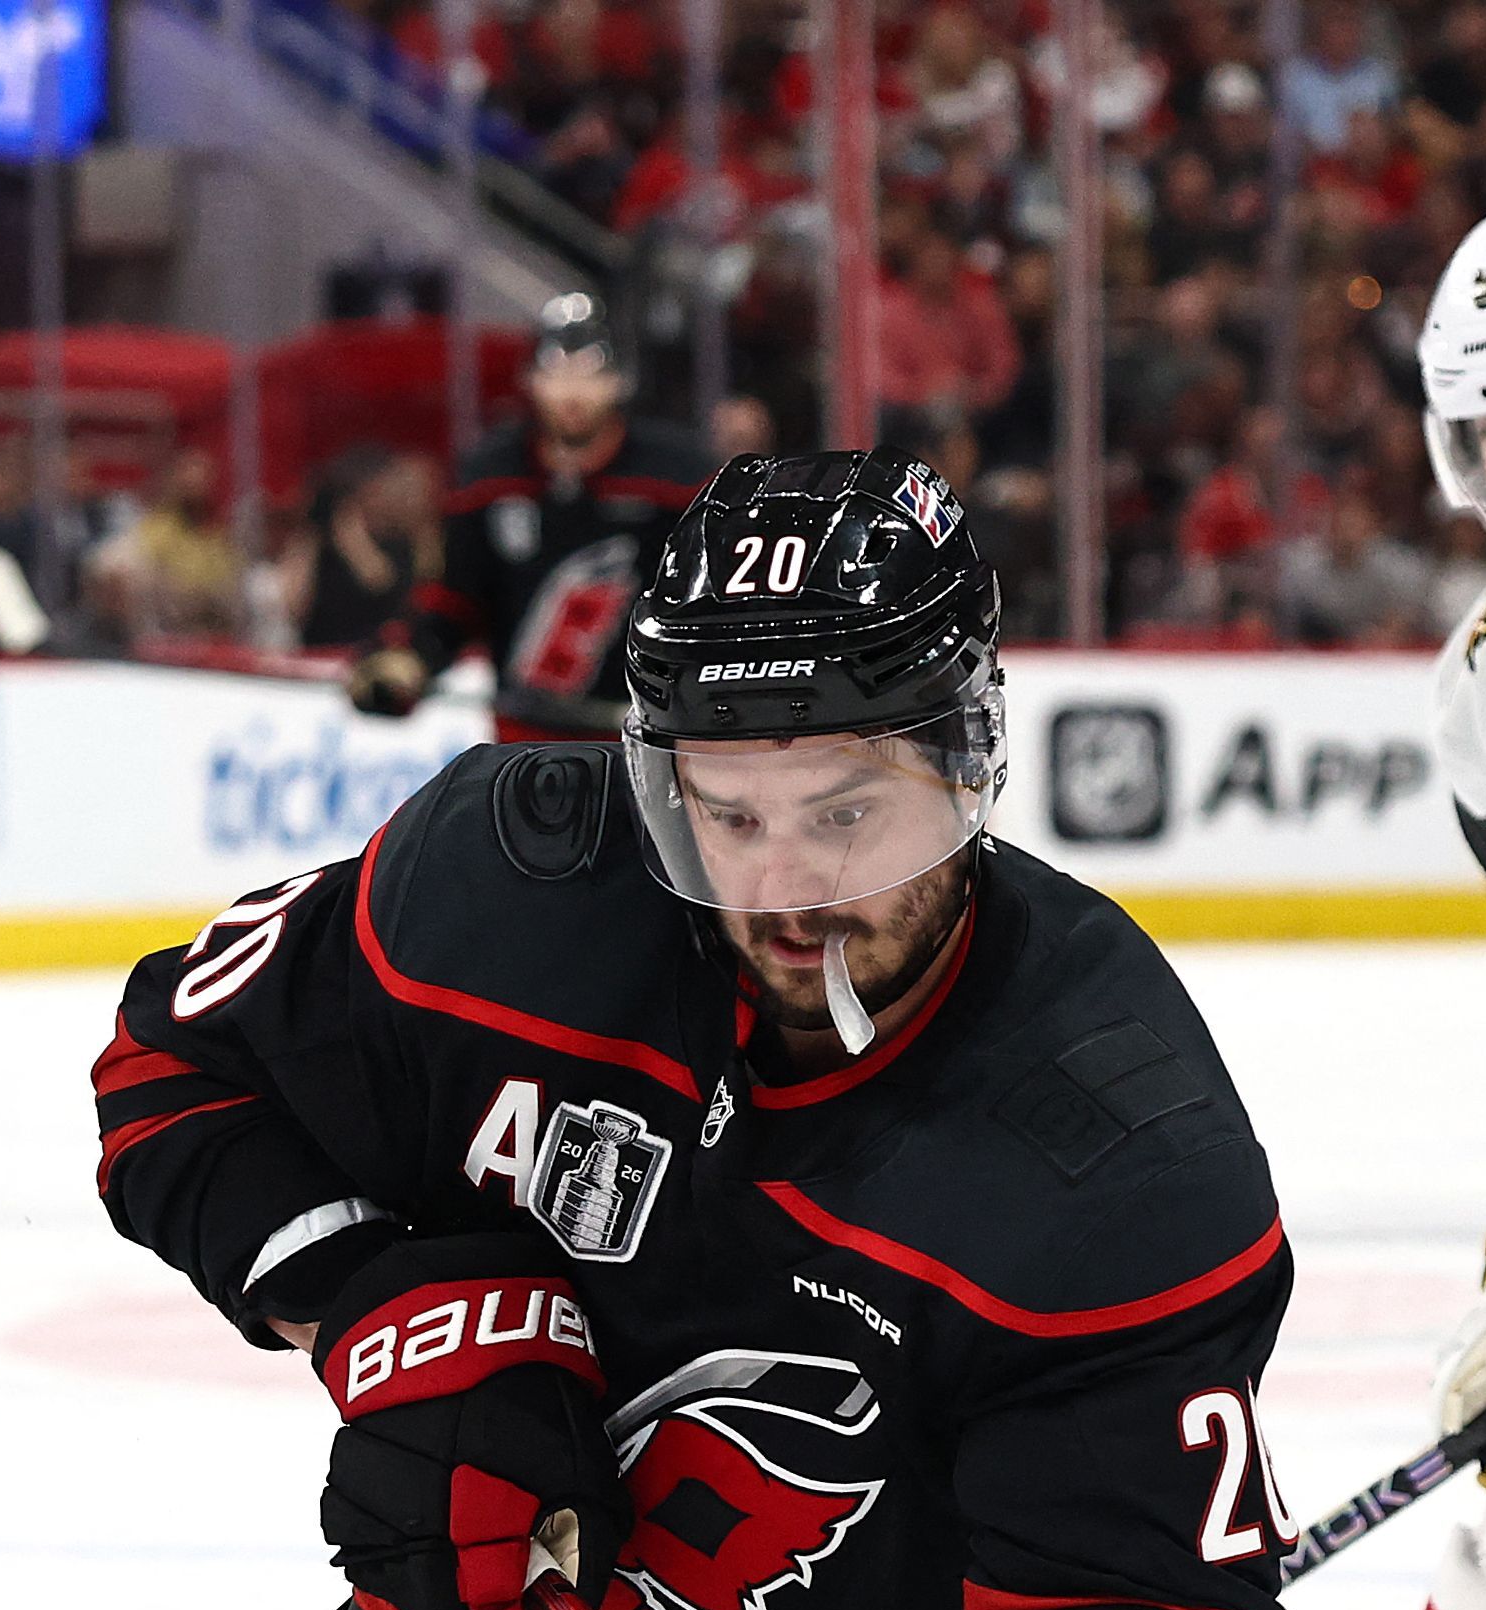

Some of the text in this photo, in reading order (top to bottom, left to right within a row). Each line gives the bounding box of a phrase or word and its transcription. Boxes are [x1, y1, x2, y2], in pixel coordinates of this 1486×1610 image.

[724, 535, 808, 595] 20
[697, 658, 817, 684] BAUER
[1201, 722, 1437, 832] App
[171, 869, 326, 1023] 20
[462, 1076, 545, 1209] A
[560, 1139, 583, 1159] 20
[620, 1163, 644, 1184] 26
[346, 1289, 597, 1404] BAUE
[793, 1275, 902, 1346] NUCOR
[1277, 1444, 1454, 1587] MOKE
